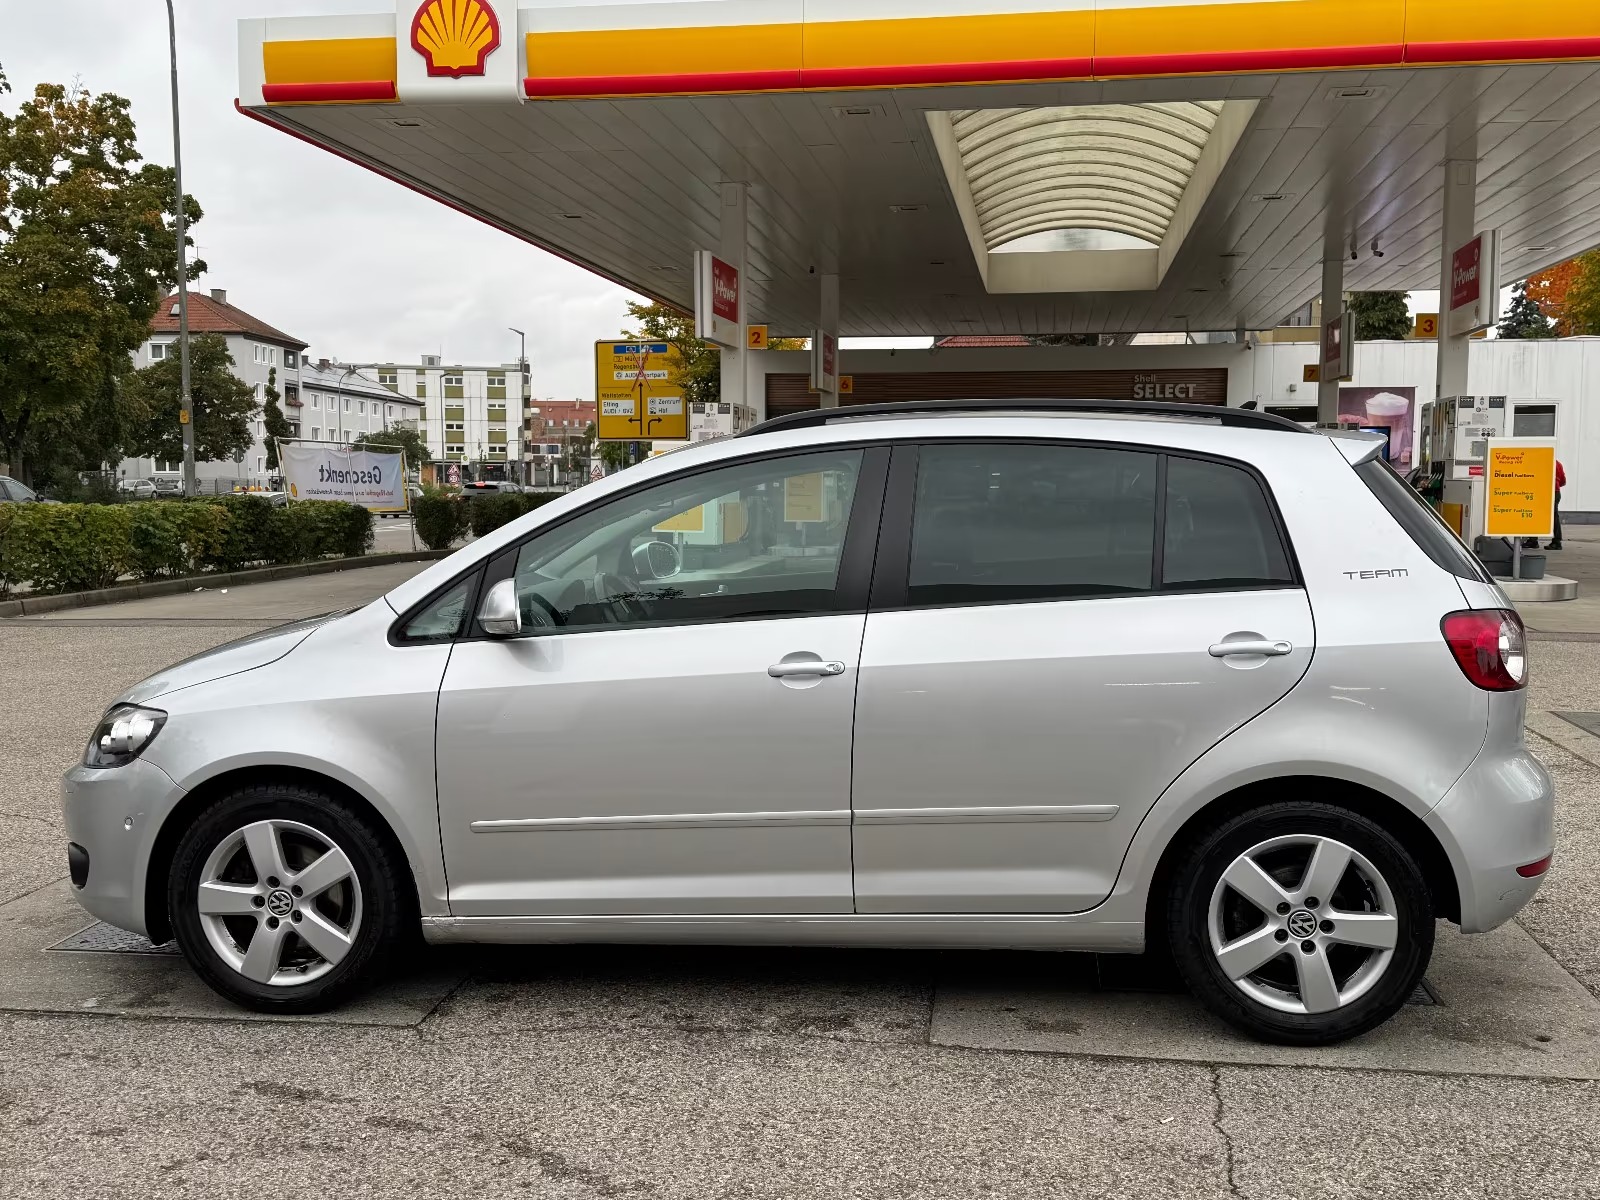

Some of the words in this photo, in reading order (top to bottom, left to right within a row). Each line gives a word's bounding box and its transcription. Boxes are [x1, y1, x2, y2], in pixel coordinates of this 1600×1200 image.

[1453, 265, 1477, 289] V-Power
[714, 276, 736, 303] V-Power
[1423, 319, 1434, 333] 3
[751, 331, 761, 344] 2
[1134, 374, 1156, 383] Shell
[1307, 368, 1315, 378] 7
[841, 380, 848, 389] 6
[1133, 383, 1197, 398] SELECT
[1343, 568, 1408, 580] TEAM
